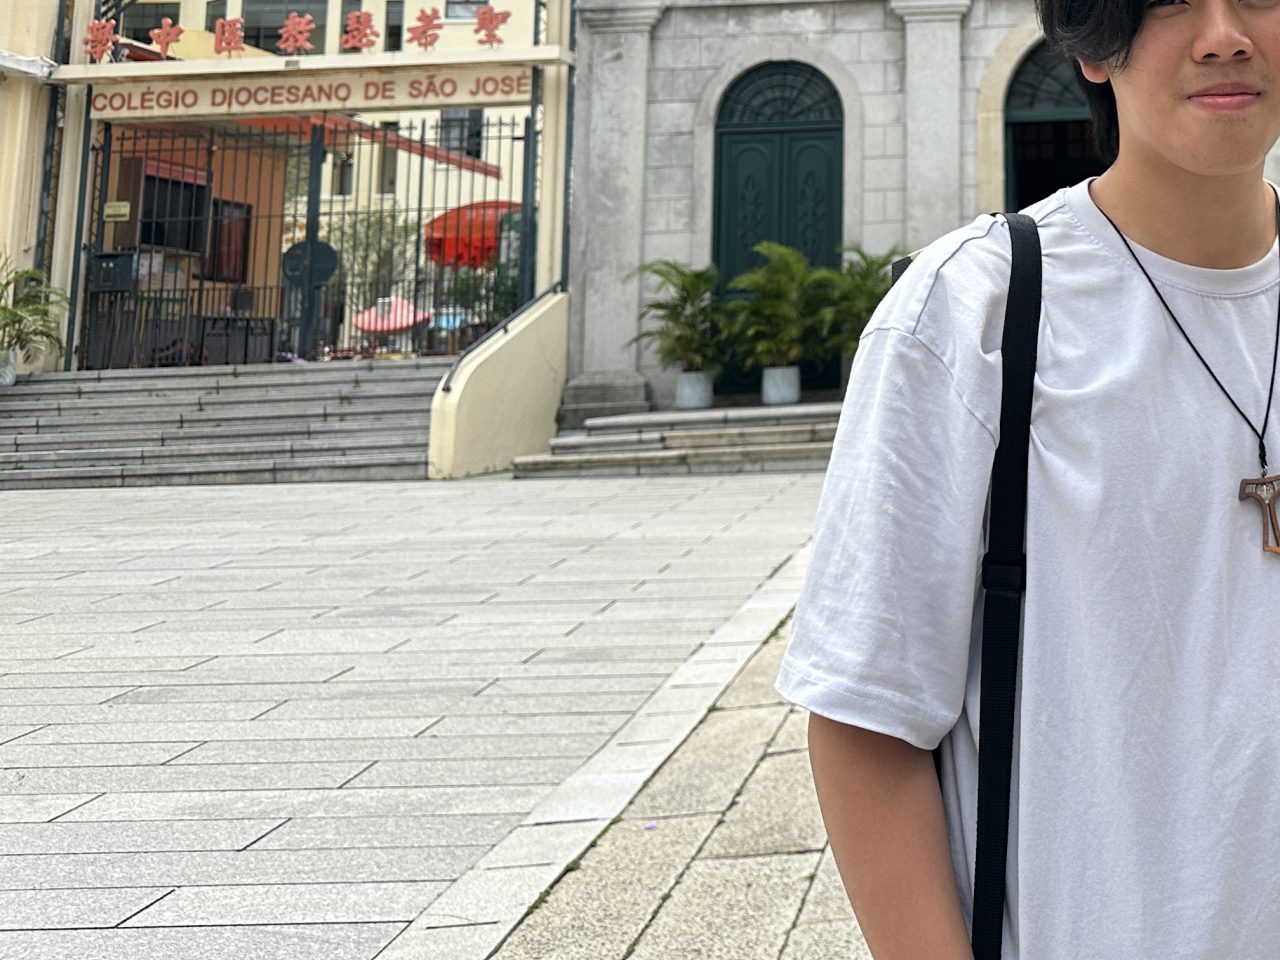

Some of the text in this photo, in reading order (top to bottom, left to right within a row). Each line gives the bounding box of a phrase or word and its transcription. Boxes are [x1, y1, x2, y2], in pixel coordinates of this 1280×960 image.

[92, 71, 530, 112] COLÉGIO DIOCESANO DE SÃO JOSÉ
